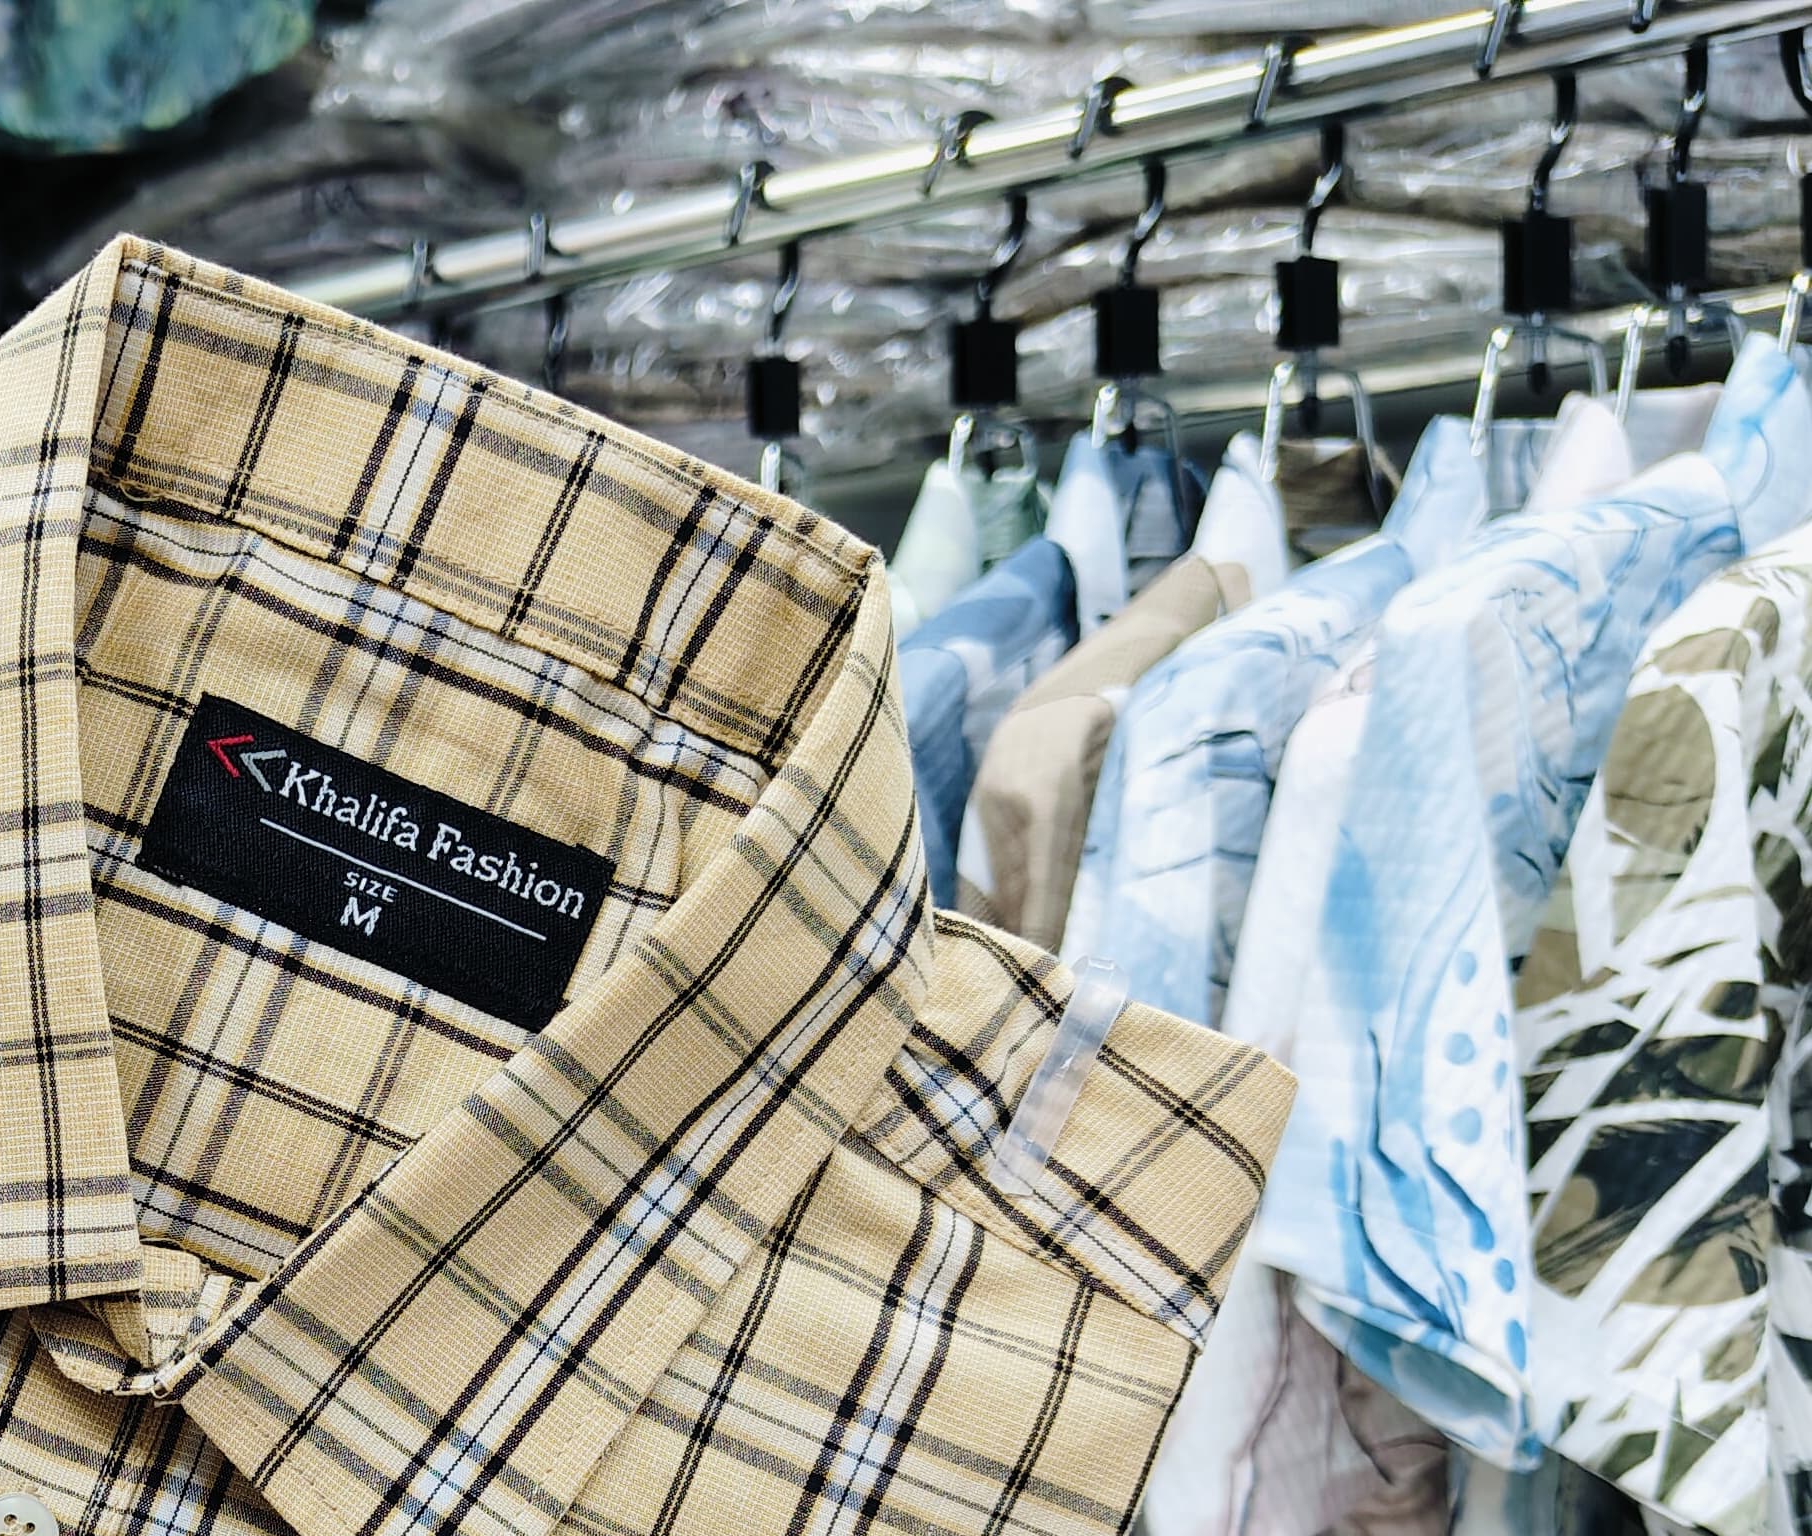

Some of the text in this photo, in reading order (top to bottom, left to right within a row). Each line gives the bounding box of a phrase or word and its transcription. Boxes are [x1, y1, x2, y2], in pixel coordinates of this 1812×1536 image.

[278, 761, 585, 919] Khalifa Fashion
[343, 871, 398, 902] SIZE
[340, 897, 382, 936] M
